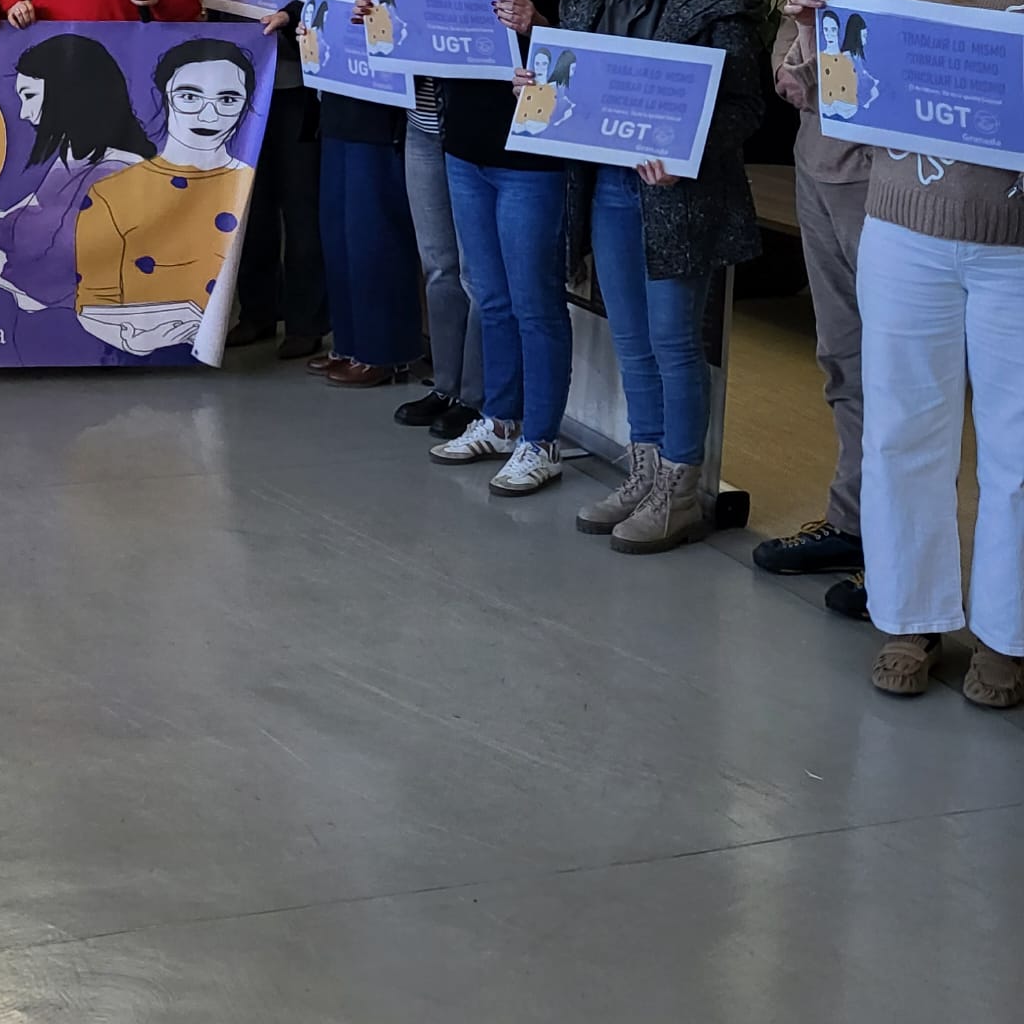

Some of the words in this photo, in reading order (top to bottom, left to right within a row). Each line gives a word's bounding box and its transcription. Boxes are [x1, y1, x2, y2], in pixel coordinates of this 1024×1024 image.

[431, 34, 472, 54] UGT
[971, 42, 1007, 59] MISMO
[914, 97, 972, 129] UGT
[600, 116, 652, 141] UGT
